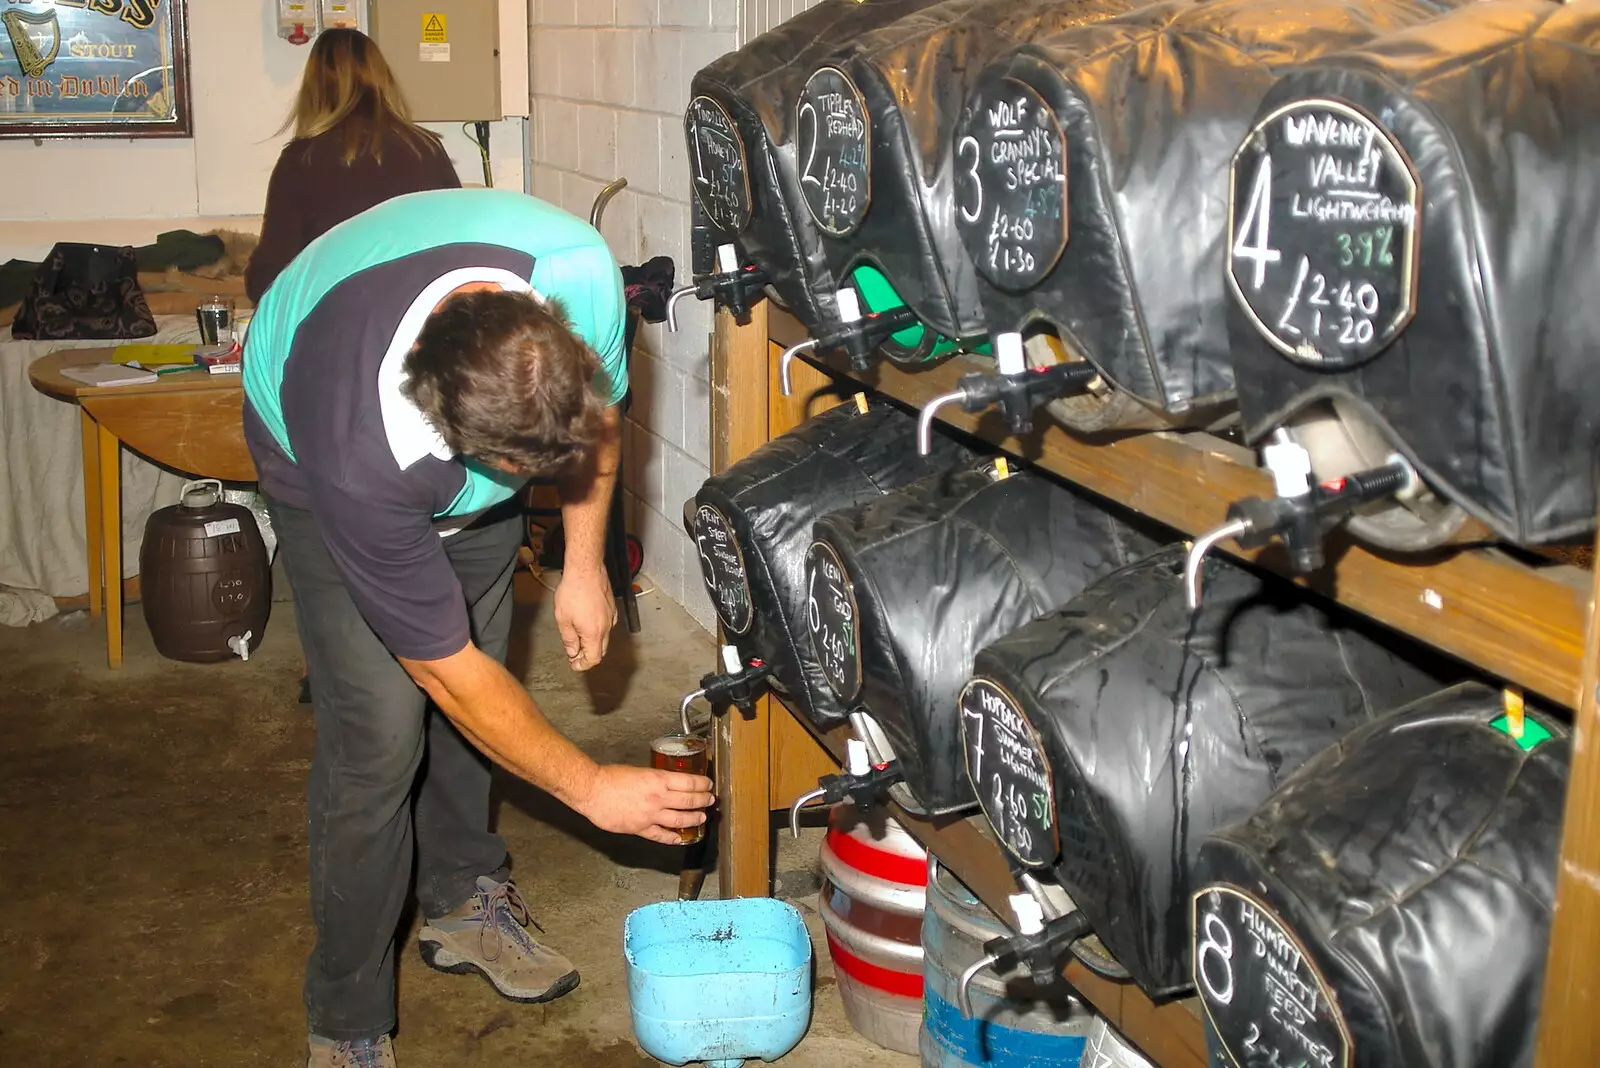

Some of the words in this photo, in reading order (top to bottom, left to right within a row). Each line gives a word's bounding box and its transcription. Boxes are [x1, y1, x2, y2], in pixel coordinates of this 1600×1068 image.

[70, 44, 137, 58] STOUT
[28, 79, 53, 97] in
[57, 73, 149, 98] Dublin
[988, 97, 1027, 128] WOLF
[691, 121, 710, 185] 1
[800, 102, 821, 187] 2
[827, 115, 865, 141] REDHEAD
[991, 126, 1053, 164] GRANNY'S
[1285, 112, 1378, 159] WAVENEY
[959, 136, 983, 223] 3
[1006, 158, 1066, 190] SPECIAL
[1310, 148, 1383, 188] VALLEY
[1233, 152, 1282, 289] 4
[697, 534, 718, 592] 5
[809, 565, 821, 634] 6
[981, 688, 1027, 740] HOPBACK
[964, 707, 985, 784] 7
[993, 724, 1036, 769] SUMMER
[1198, 912, 1234, 1006] 8
[1240, 900, 1301, 972] HUMPTY
[1248, 927, 1318, 1014] DUMPTY
[1264, 975, 1306, 1026] REED
[1269, 1006, 1336, 1068] CUTTER
